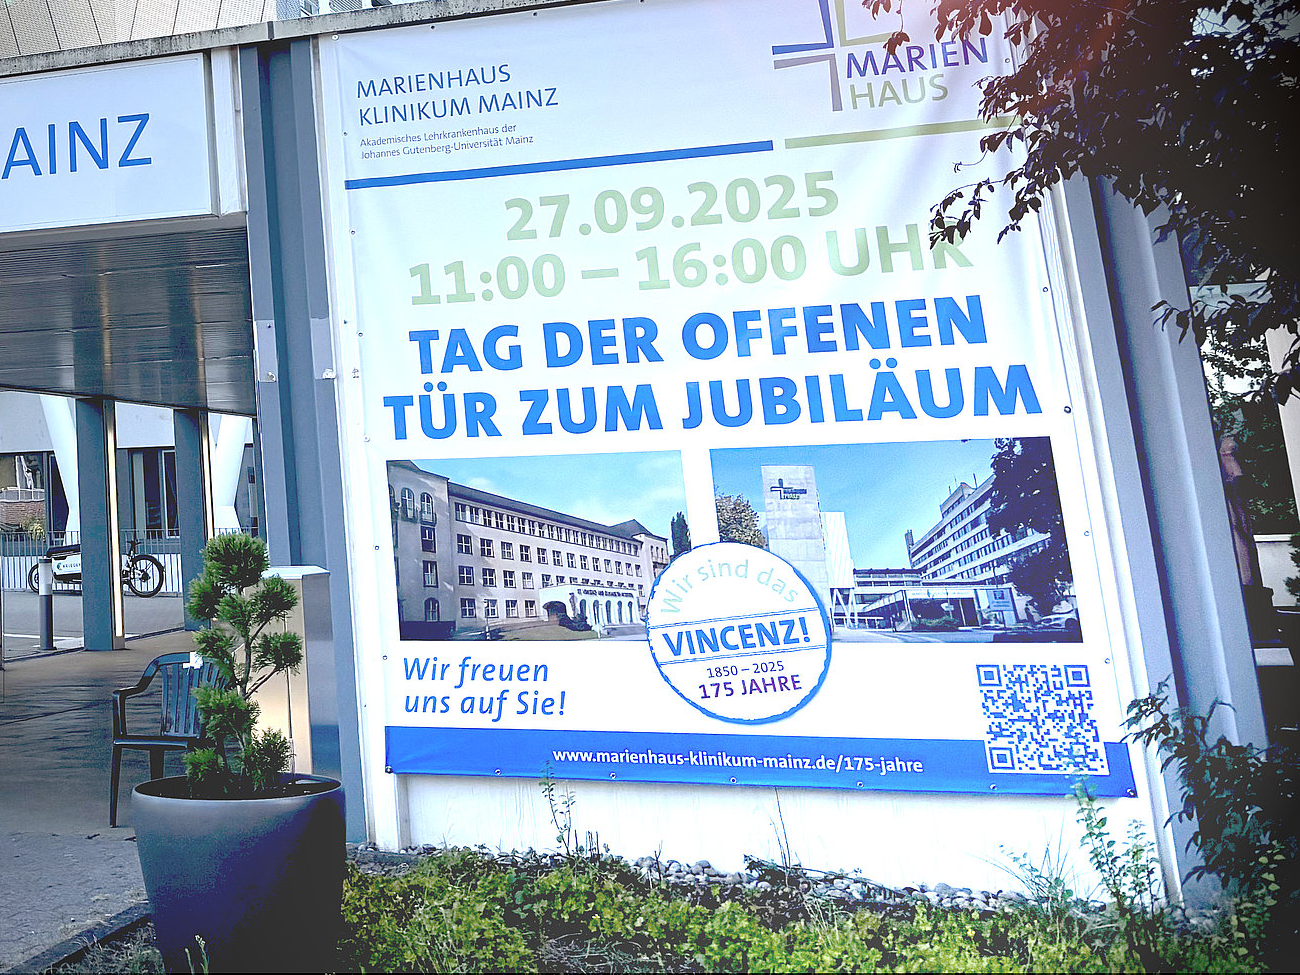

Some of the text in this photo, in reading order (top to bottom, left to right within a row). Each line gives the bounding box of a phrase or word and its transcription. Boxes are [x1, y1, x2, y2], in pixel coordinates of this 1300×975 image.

[847, 37, 988, 78] MARIEN
[357, 64, 511, 99] MARIENHAUS
[850, 74, 949, 110] HAUS
[359, 87, 559, 126] KLINIKUM MAINZ
[360, 123, 517, 147] Akademisches Lehrkrankenhaus der
[360, 134, 534, 159] Johannes Gutenberg-Universität Mainz
[504, 170, 839, 242] 27.09.2025
[409, 253, 566, 306] 11:00
[636, 234, 807, 293] 16:00
[409, 294, 988, 375] TAG DER OFFENEN
[383, 357, 1043, 441] TÜR ZUM JUBILÄUM
[661, 559, 799, 614] Wir sind das
[662, 616, 811, 657] VINCENZ!
[403, 656, 549, 689] Wir freuen
[698, 674, 803, 699] 175 JAHRE
[706, 665, 738, 678] 1850
[753, 660, 785, 674] 2025
[404, 689, 567, 722] uns auf Sie!
[552, 748, 924, 775] www.marienhaus-klinikum-mainz.de/175-jahre
